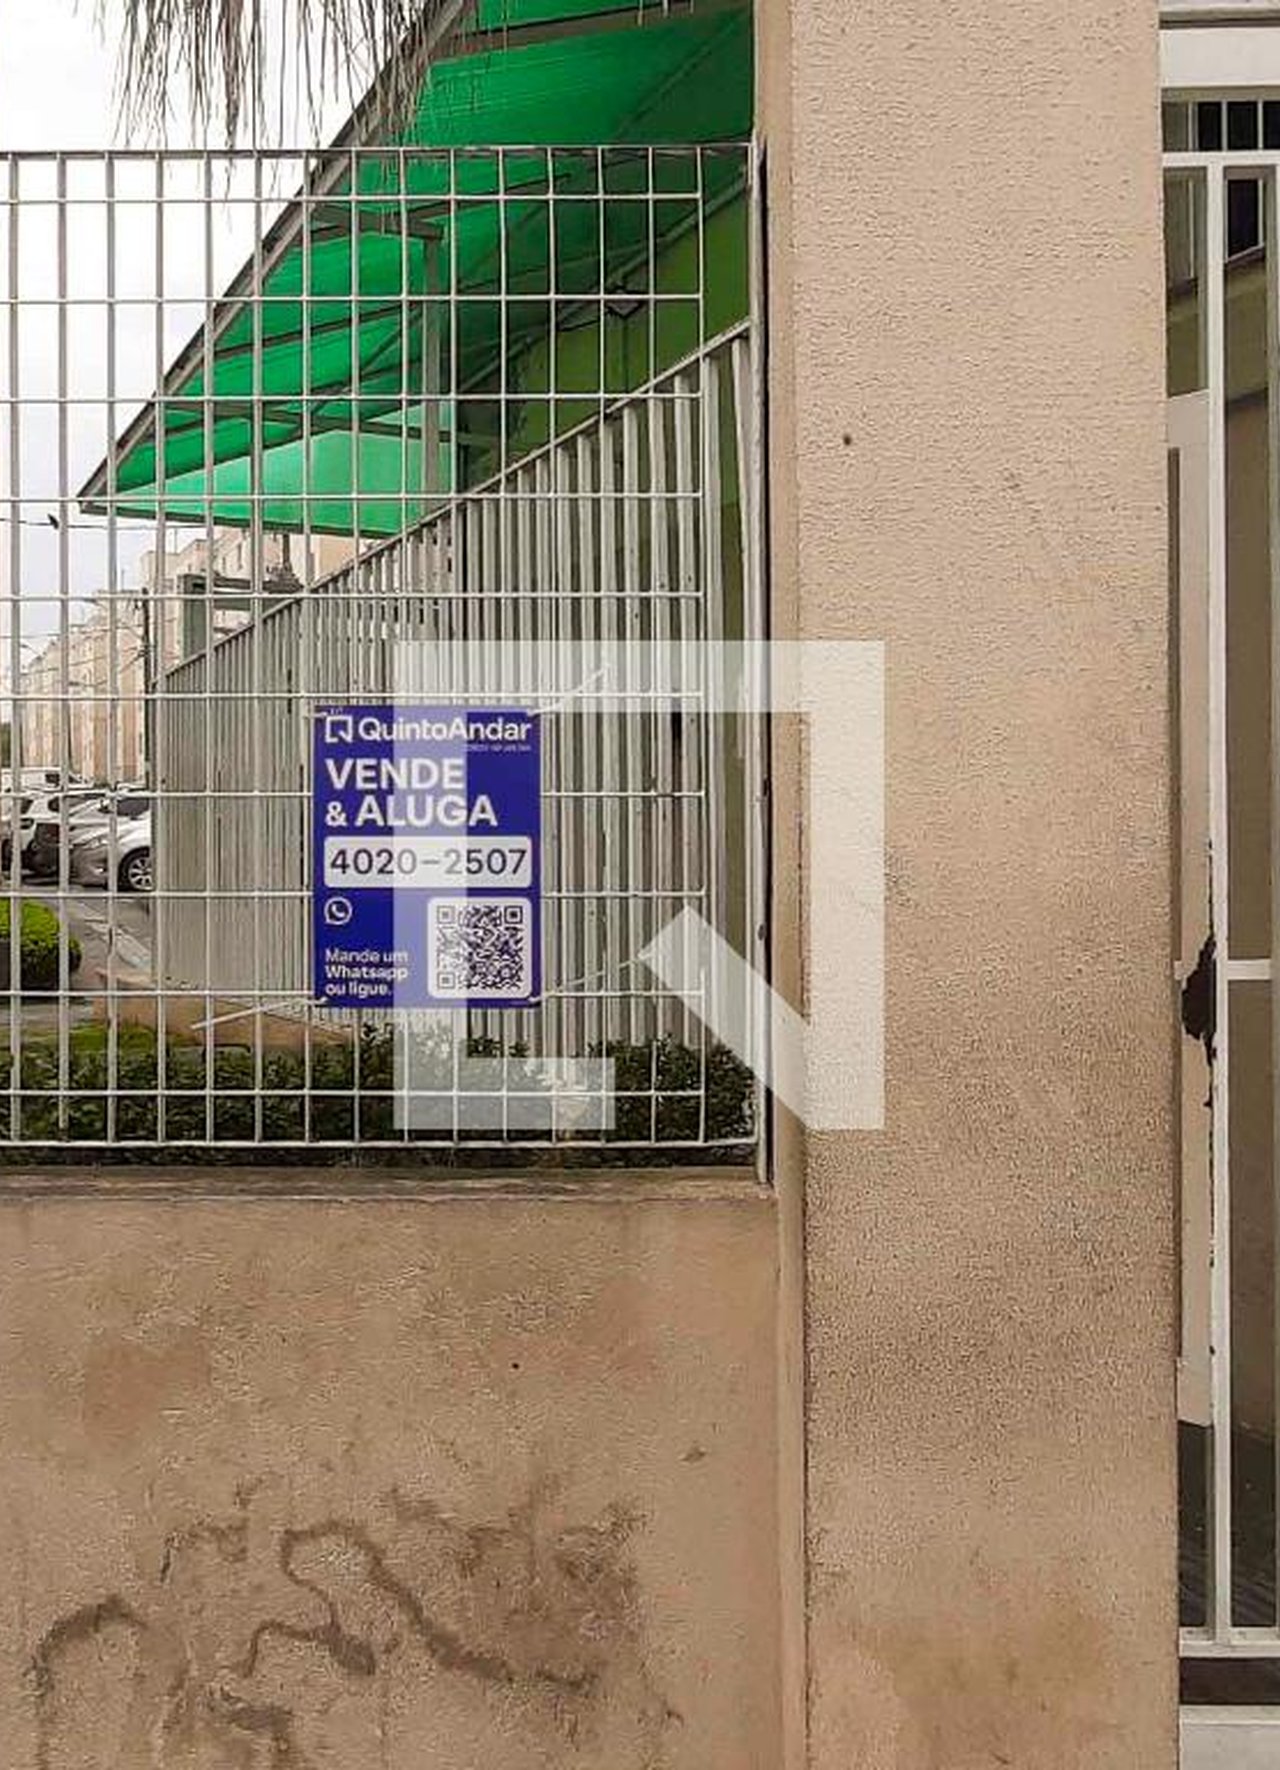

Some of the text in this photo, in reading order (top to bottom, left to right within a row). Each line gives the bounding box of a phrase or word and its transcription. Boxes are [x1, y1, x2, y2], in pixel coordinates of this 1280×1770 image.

[358, 717, 532, 741] QuintoAndar
[325, 758, 465, 790] VENDE
[324, 795, 499, 827] & ALUGA
[330, 848, 528, 876] 4020-2507
[324, 947, 410, 963] Mande um
[324, 964, 410, 982] Whatsapp
[324, 980, 392, 998] ou ligue.
